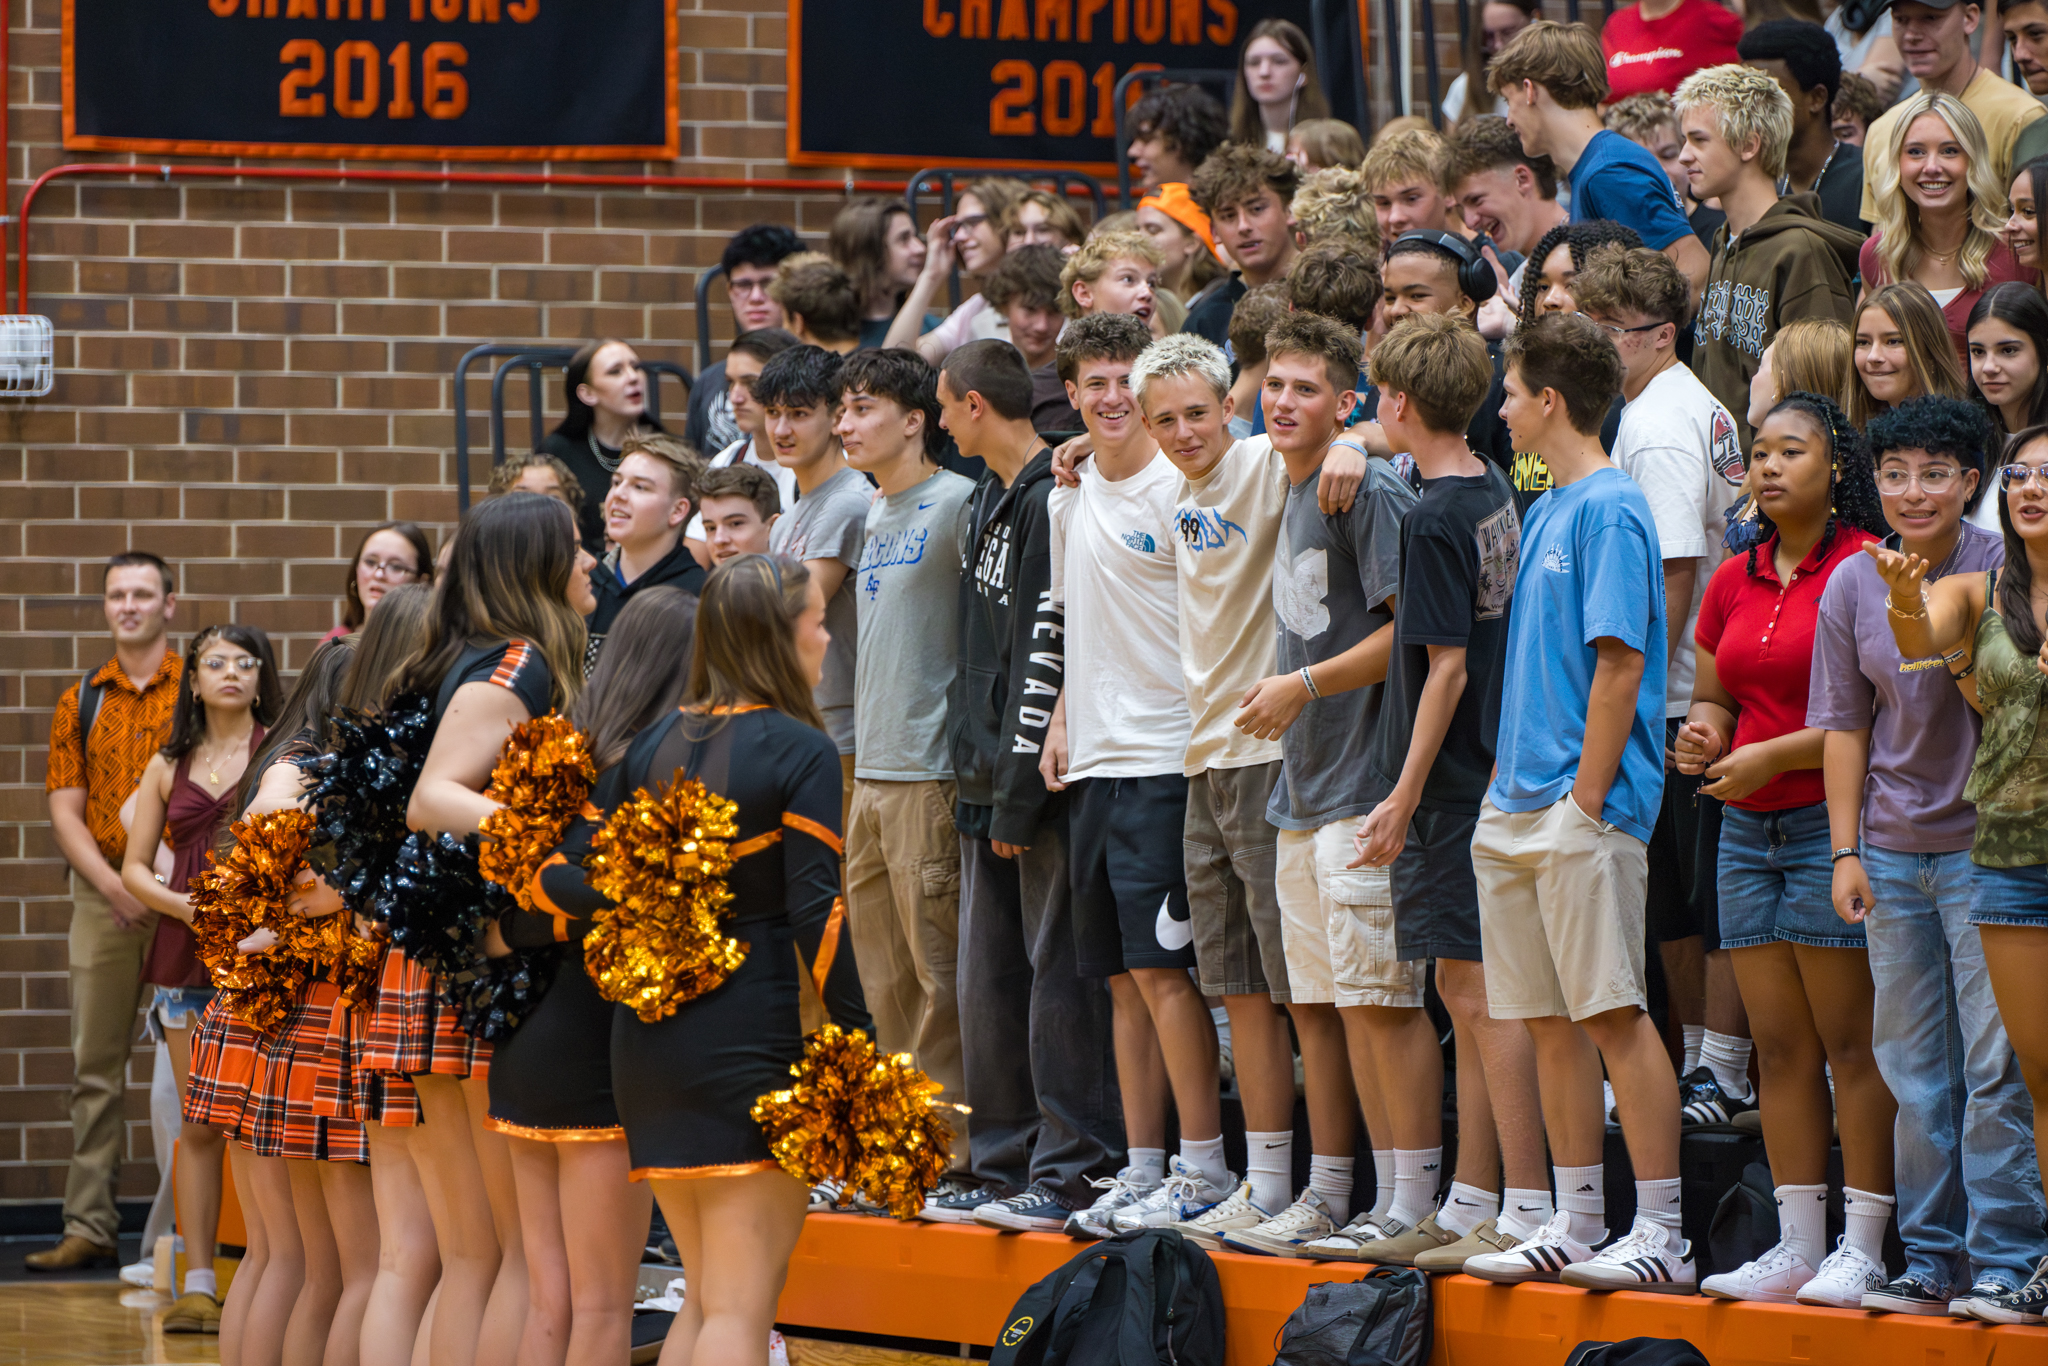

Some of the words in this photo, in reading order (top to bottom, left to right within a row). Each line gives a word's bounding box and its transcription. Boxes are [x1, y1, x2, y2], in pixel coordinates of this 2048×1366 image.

[922, 0, 1238, 46] CHAMPIONS
[278, 38, 469, 119] 2016
[1121, 532, 1144, 546] NORTH
[1125, 539, 1144, 551] FACE
[1133, 529, 1146, 539] THE
[1011, 590, 1065, 754] NEVADA
